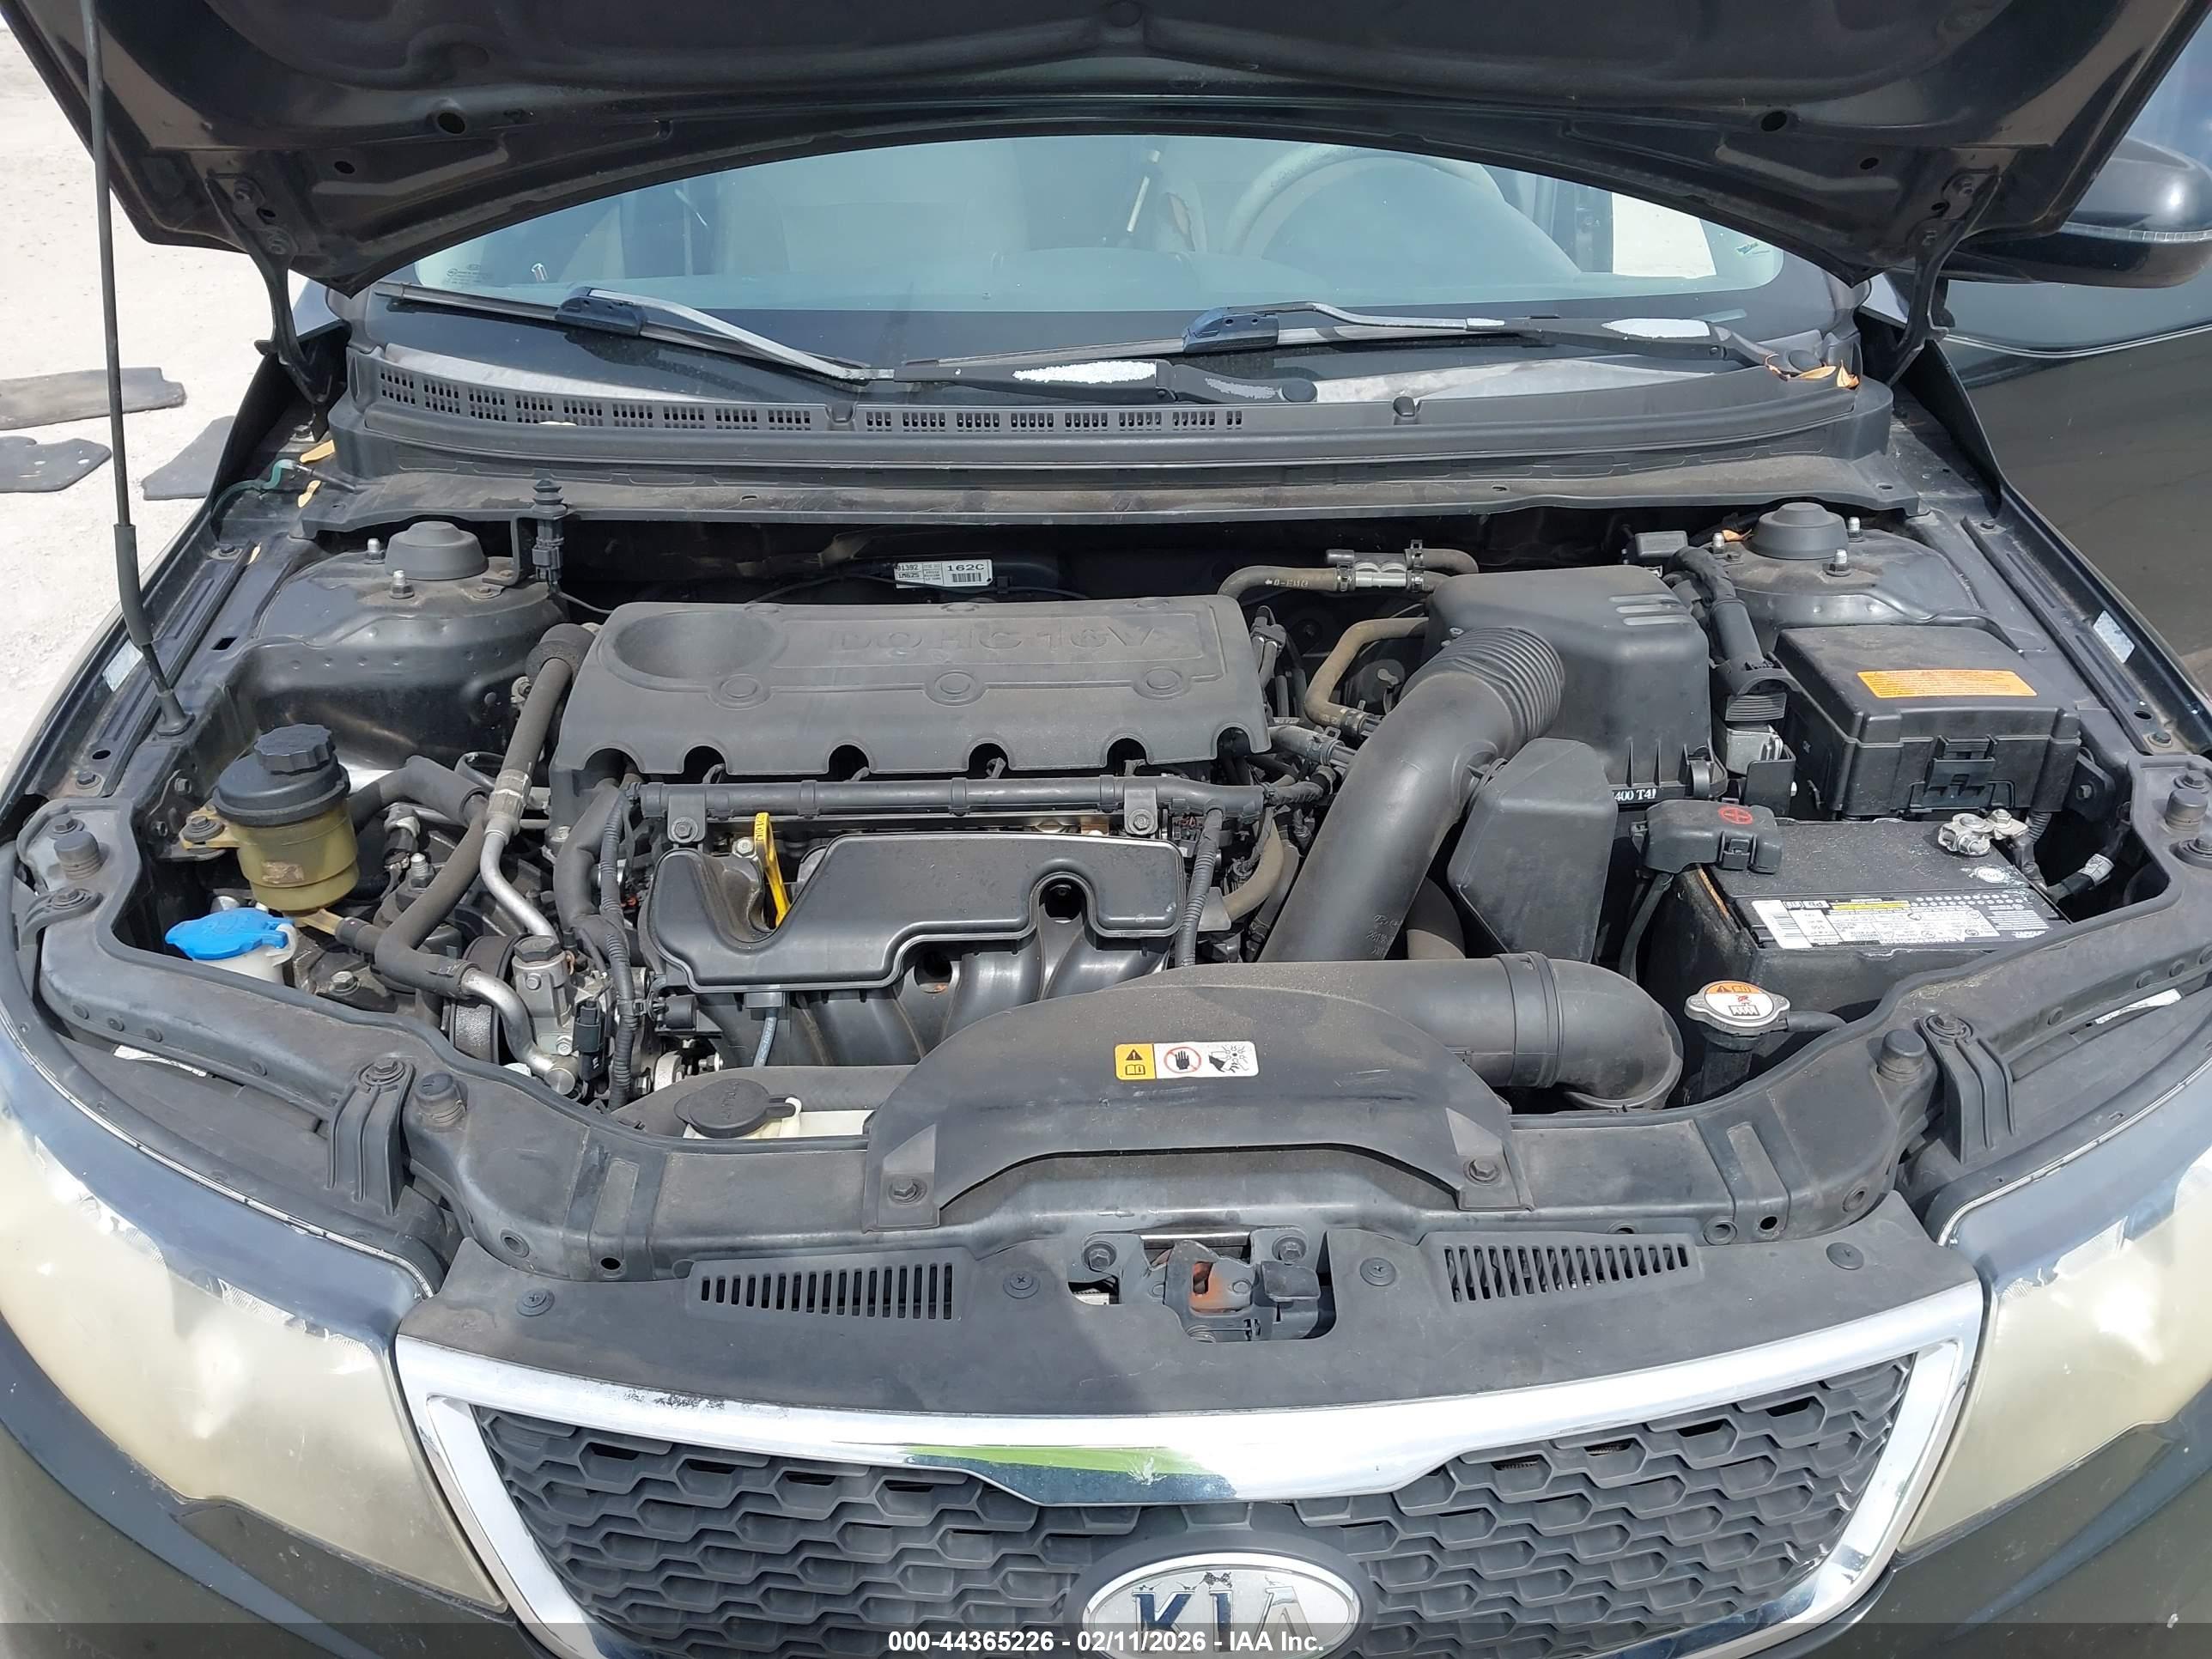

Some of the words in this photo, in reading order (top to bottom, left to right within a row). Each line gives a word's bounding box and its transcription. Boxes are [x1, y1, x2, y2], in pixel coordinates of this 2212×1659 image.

[947, 563, 984, 572] 162C
[831, 629, 1023, 650] DOHC
[1036, 625, 1155, 649] 16V
[1132, 1586, 1319, 1654] KIA
